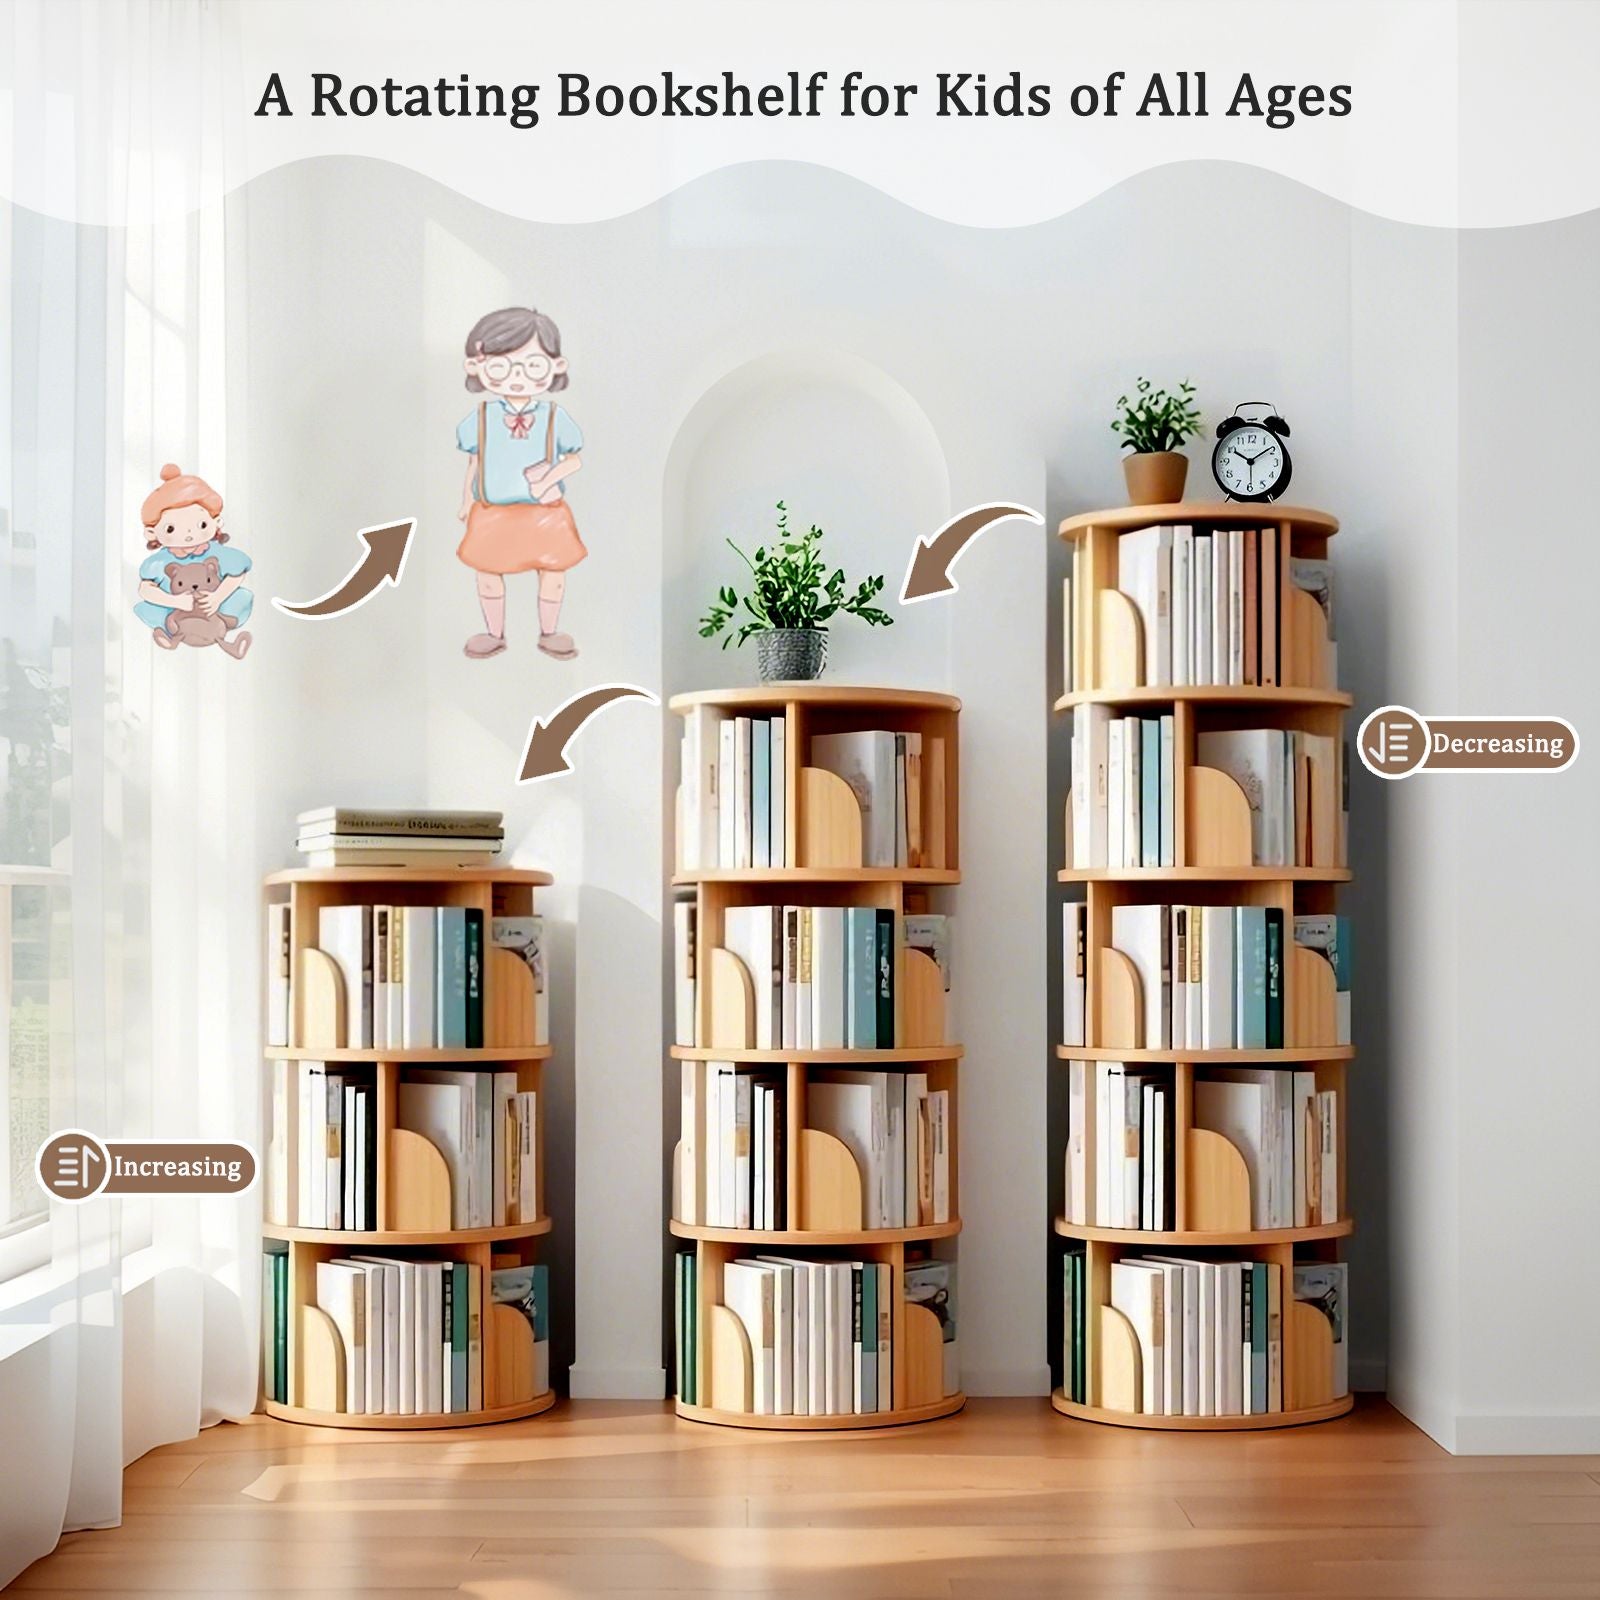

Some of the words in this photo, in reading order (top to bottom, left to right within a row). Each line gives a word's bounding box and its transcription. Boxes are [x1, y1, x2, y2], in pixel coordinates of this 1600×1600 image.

[1237, 437, 1244, 445] 11
[1247, 435, 1257, 444] 12
[1262, 437, 1266, 445] 1
[1273, 459, 1278, 467] 3
[1226, 470, 1233, 478] 8
[1236, 480, 1241, 488] 7
[1247, 483, 1253, 492] 6
[1260, 480, 1266, 489] 5
